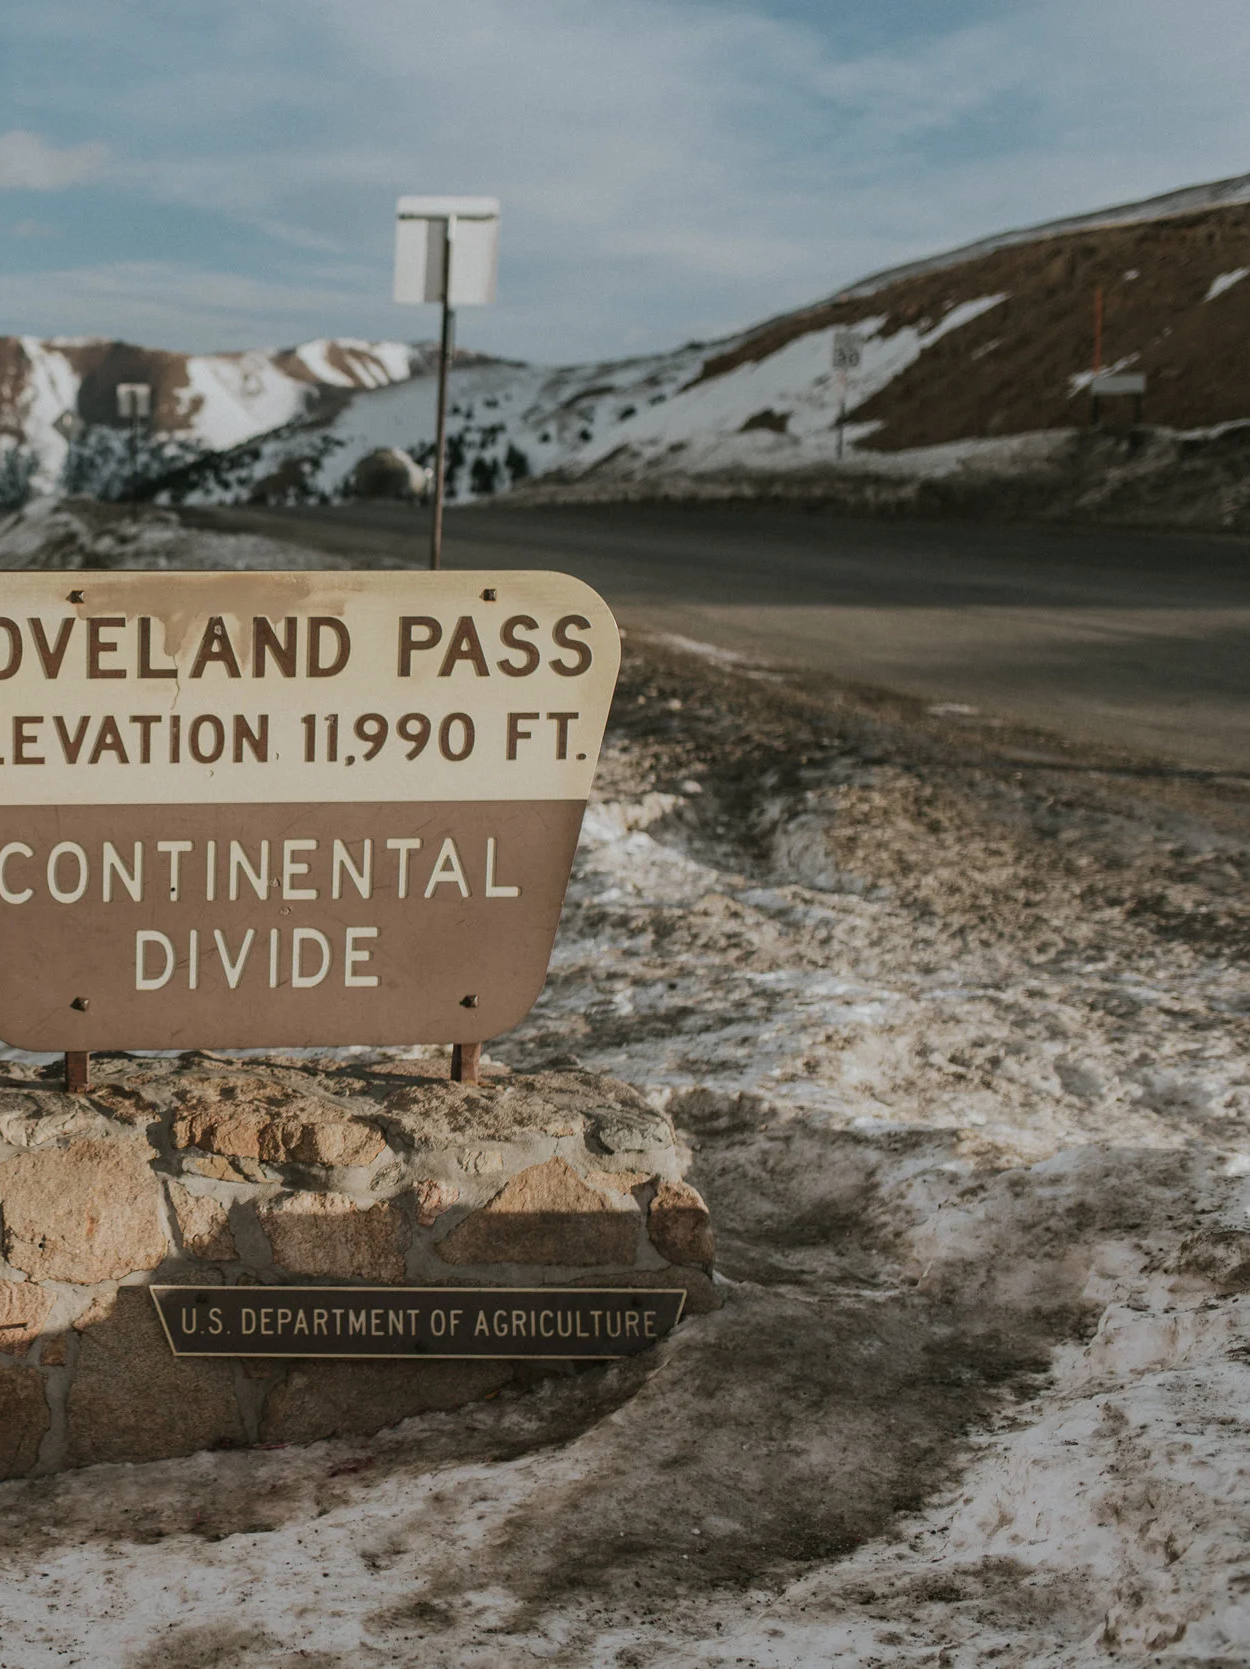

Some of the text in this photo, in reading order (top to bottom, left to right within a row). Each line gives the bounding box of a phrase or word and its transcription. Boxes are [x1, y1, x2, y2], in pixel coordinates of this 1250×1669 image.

[396, 613, 593, 677] PASS
[300, 712, 476, 768] 11,990
[506, 711, 588, 761] FT.
[136, 926, 381, 990] DIVIDE
[182, 1308, 656, 1338] U.S. DEPARTMENT OF AGRICULTURE
